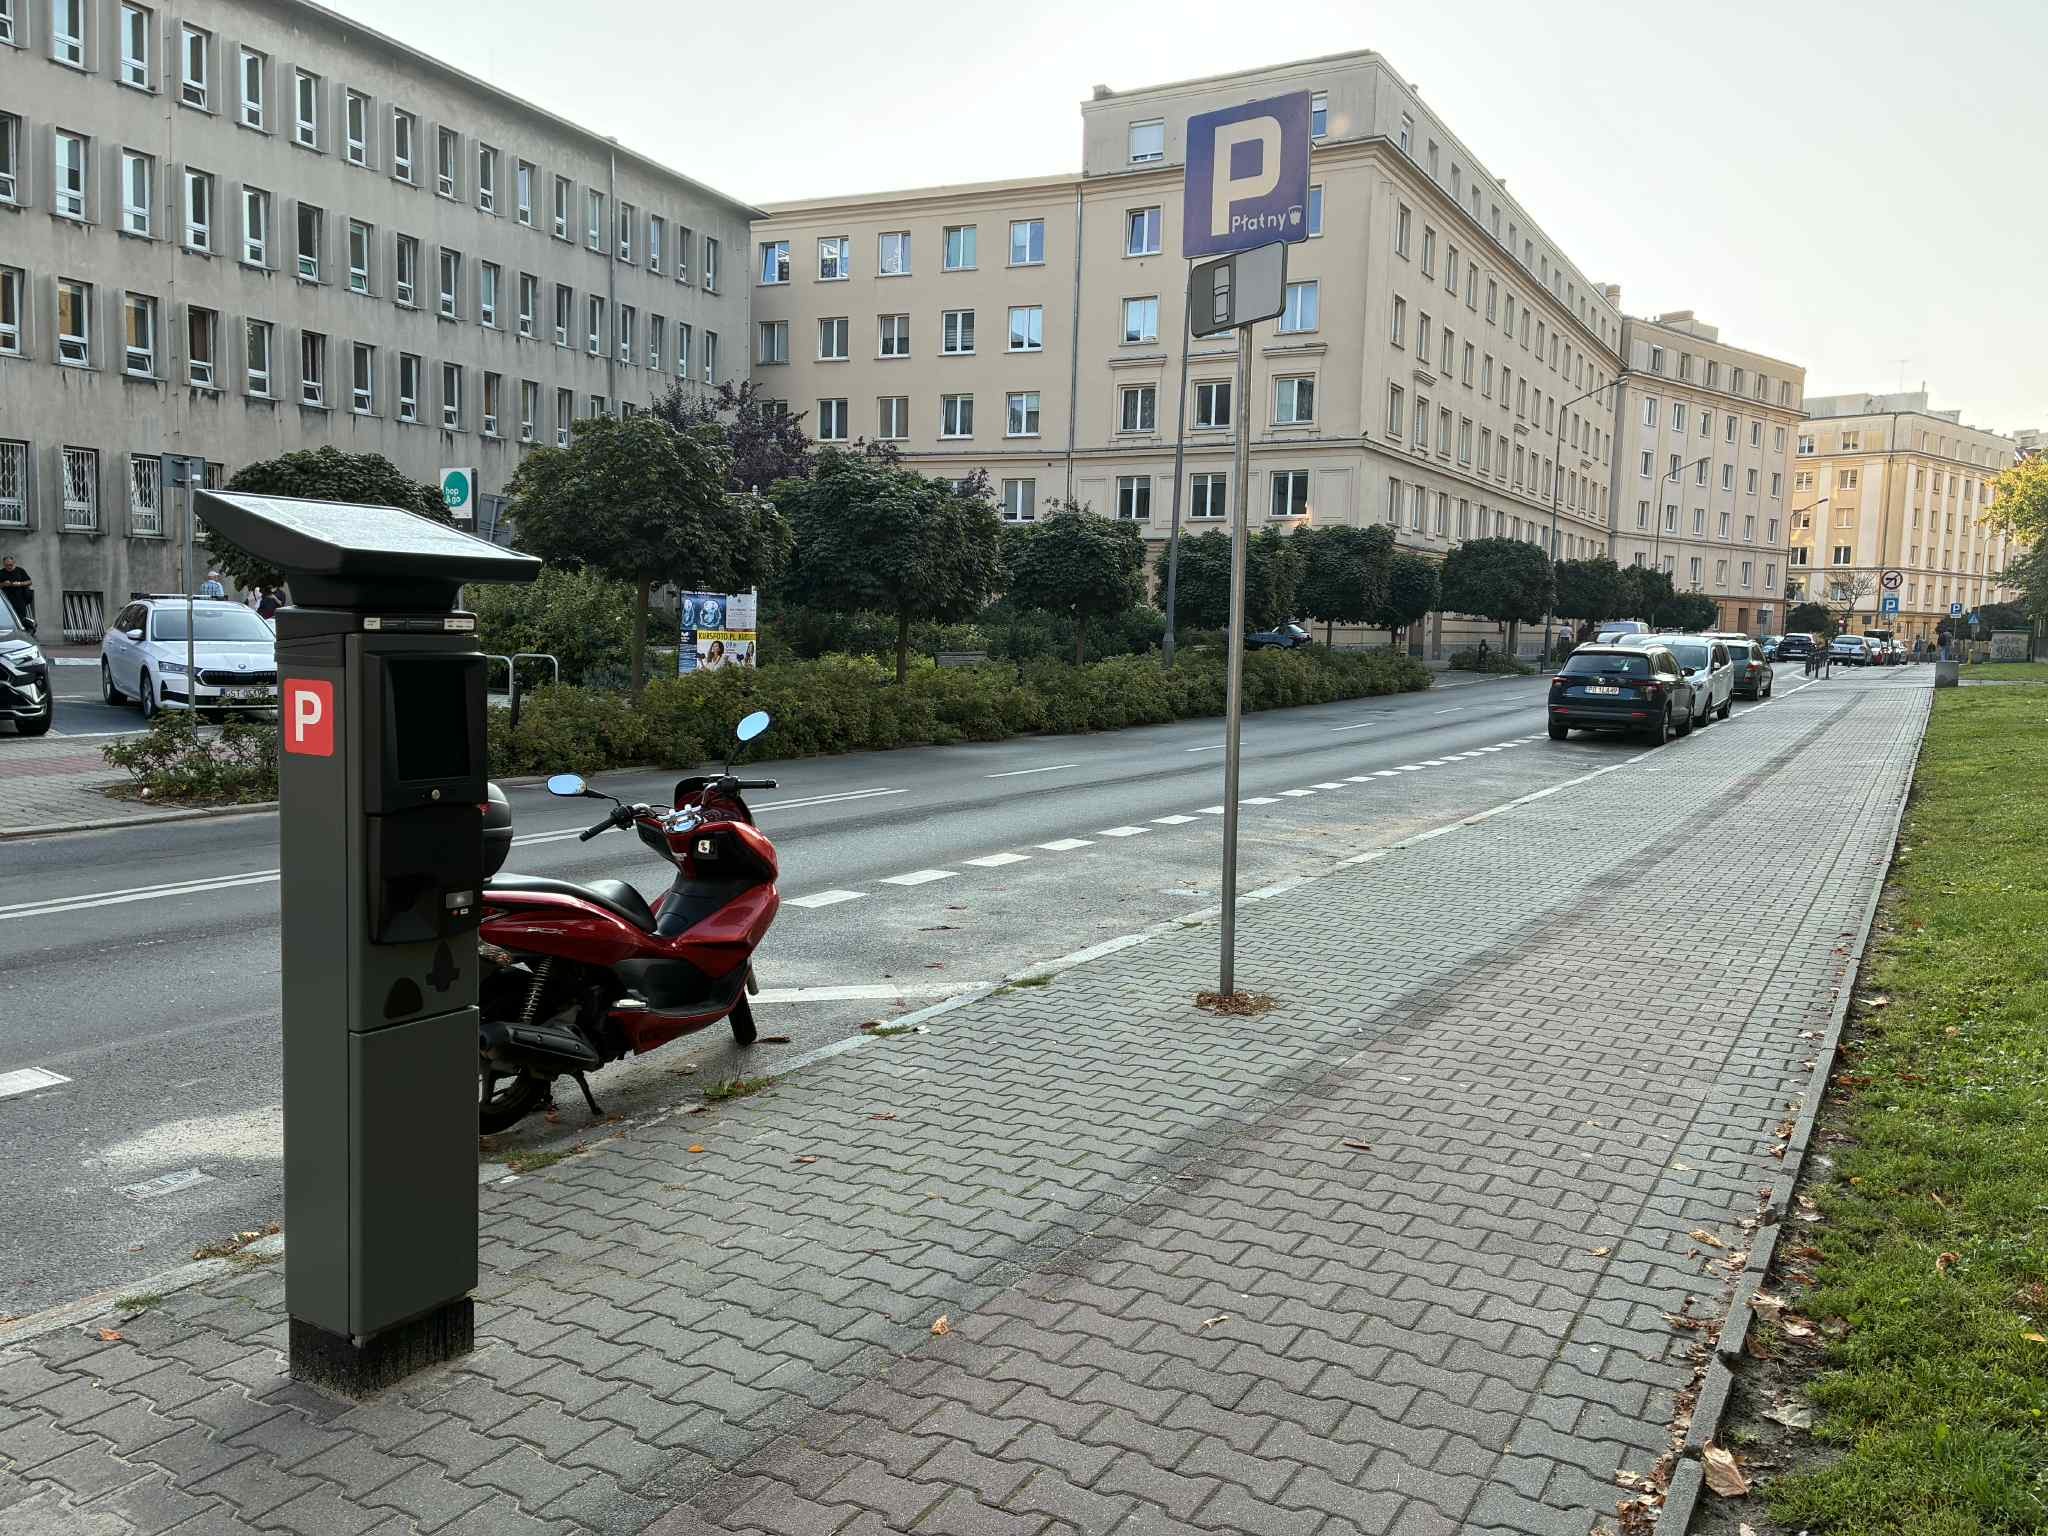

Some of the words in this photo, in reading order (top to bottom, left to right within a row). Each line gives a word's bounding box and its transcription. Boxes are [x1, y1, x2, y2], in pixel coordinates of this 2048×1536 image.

[1211, 115, 1282, 236] P
[1232, 213, 1286, 232] Płatny
[1885, 600, 1896, 611] P
[1953, 604, 1960, 613] P
[294, 690, 322, 742] P
